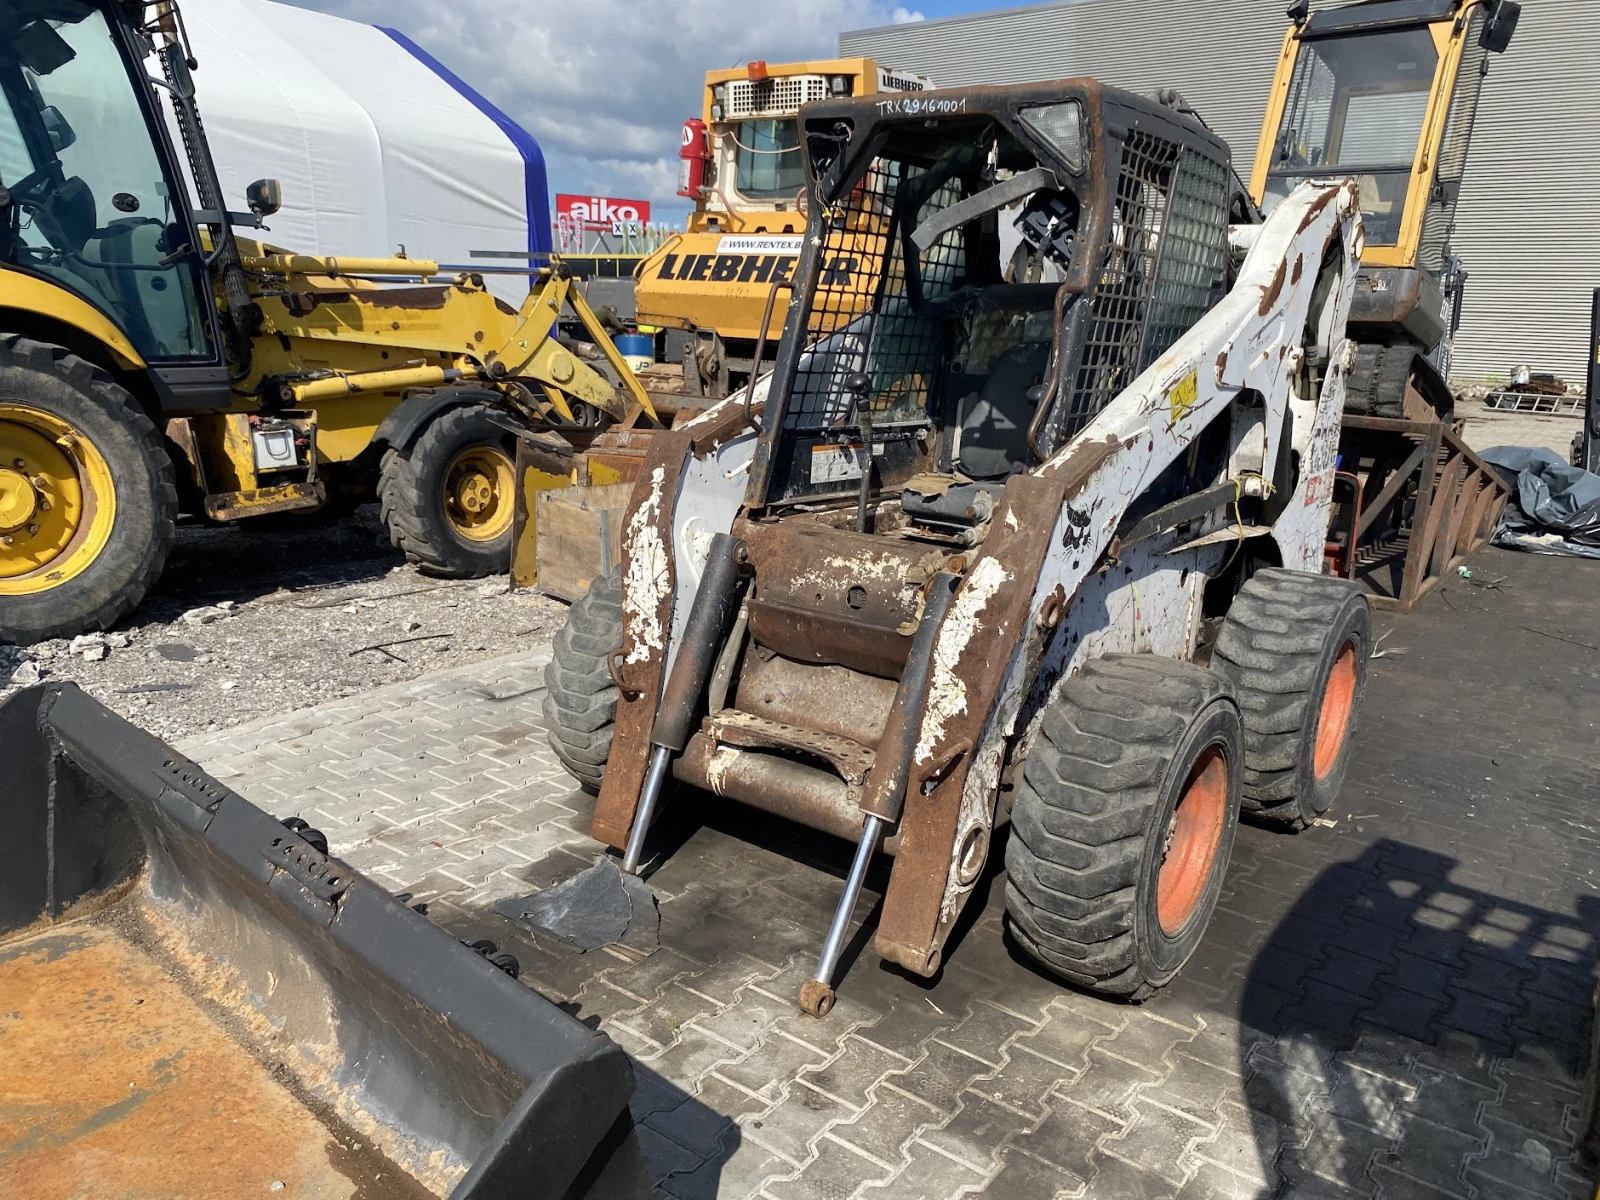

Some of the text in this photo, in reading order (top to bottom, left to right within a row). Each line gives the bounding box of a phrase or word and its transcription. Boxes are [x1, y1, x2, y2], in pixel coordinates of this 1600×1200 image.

[882, 75, 924, 91] LIEBHERR
[570, 198, 639, 222] aiko
[728, 240, 802, 249] WWW.RENTEX.B
[656, 254, 858, 287] LIEBHER
